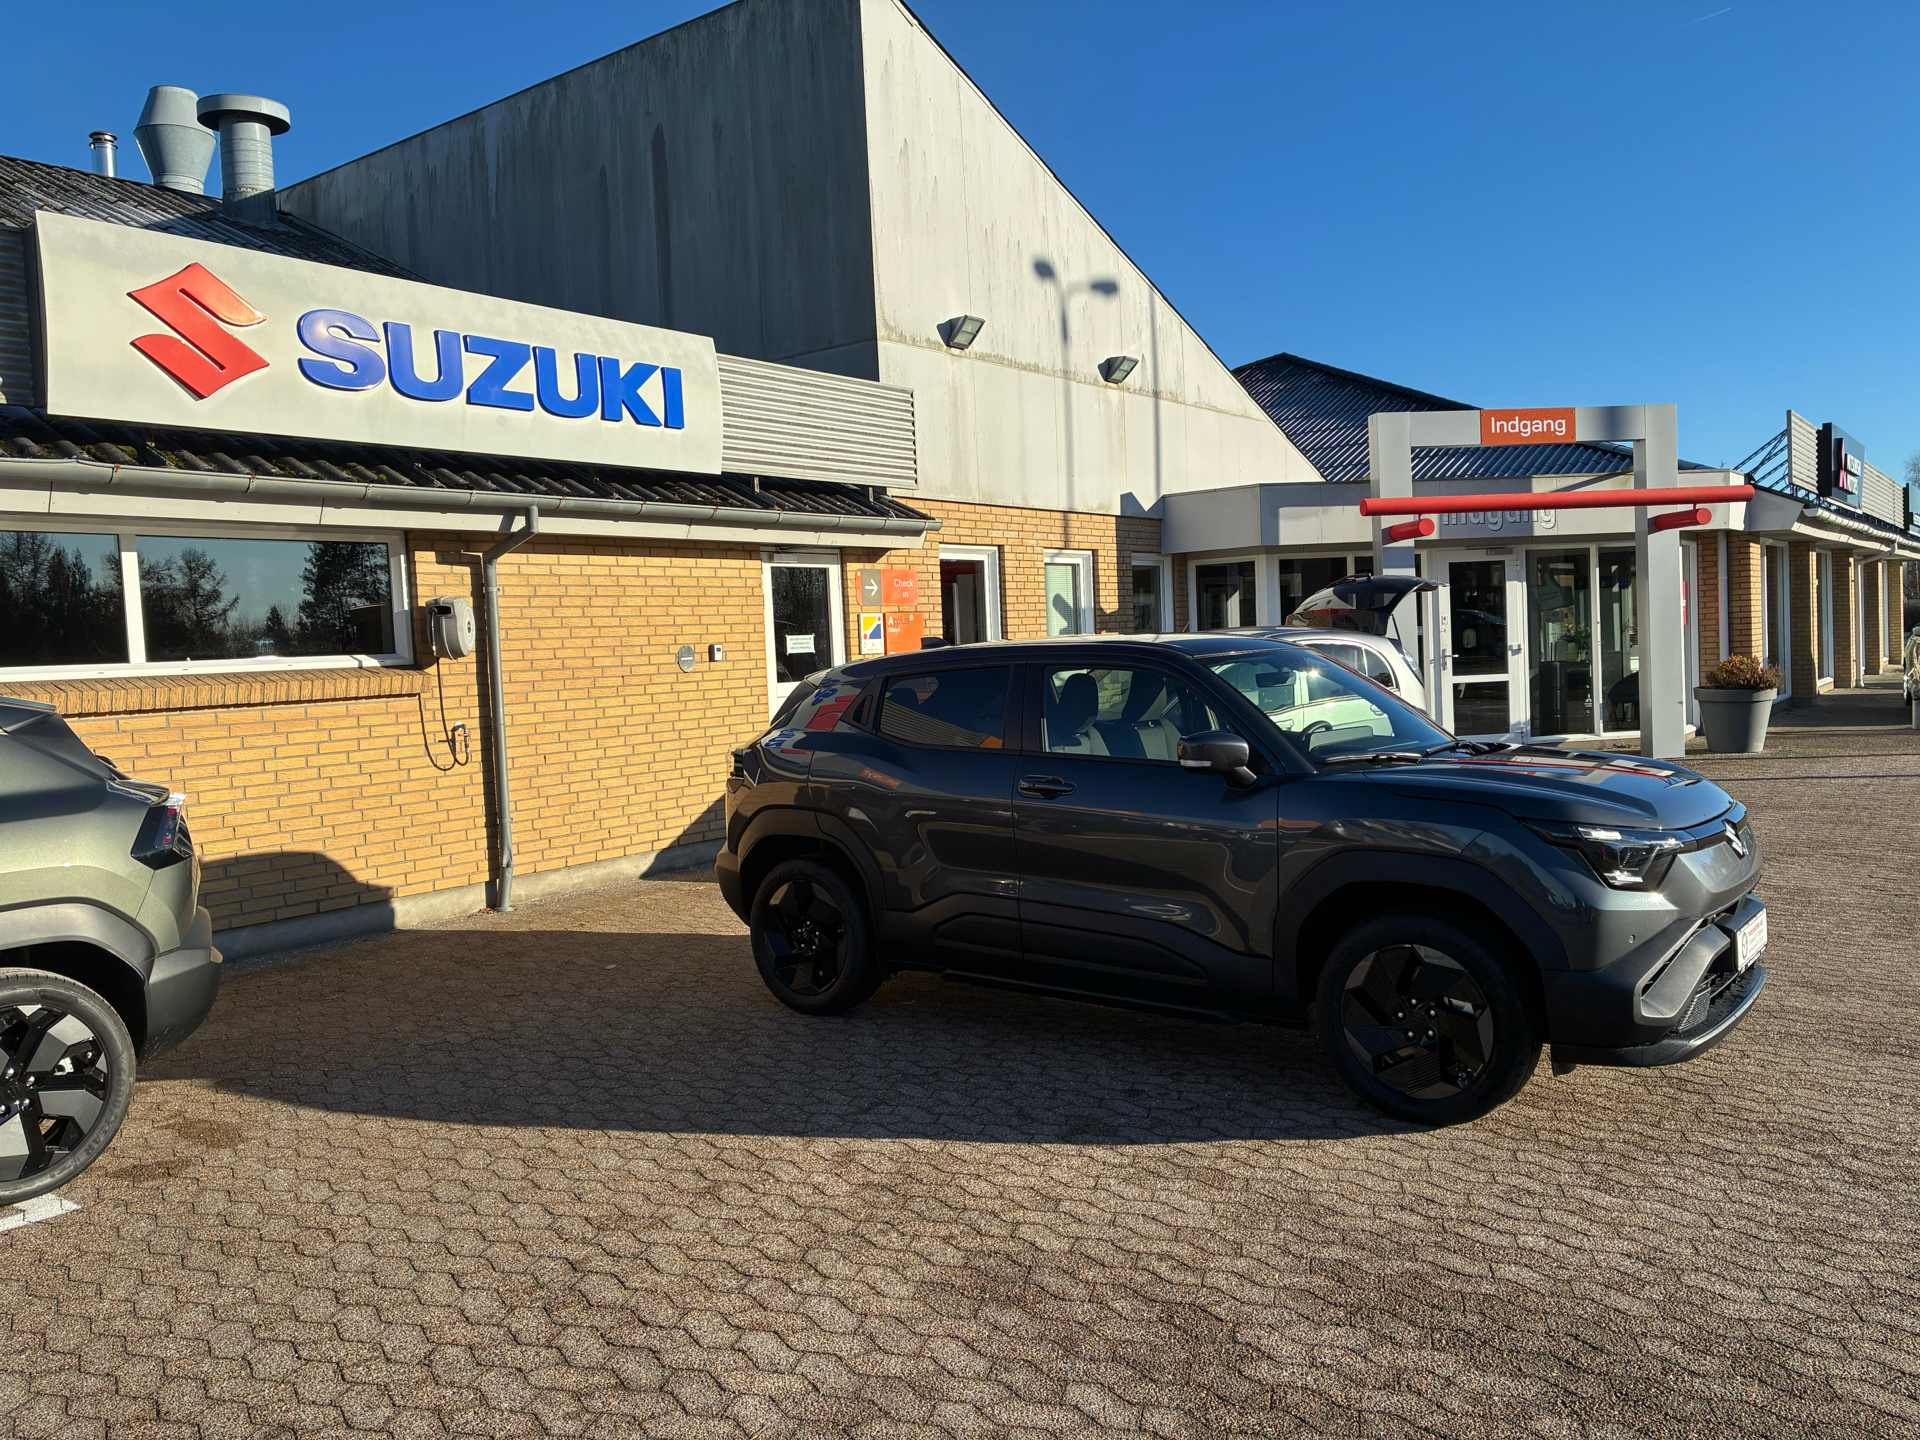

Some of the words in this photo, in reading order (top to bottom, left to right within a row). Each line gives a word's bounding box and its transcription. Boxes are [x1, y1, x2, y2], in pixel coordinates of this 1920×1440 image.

[297, 309, 684, 429] SUZUKI
[1491, 416, 1566, 437] Indgang
[893, 578, 914, 587] Check
